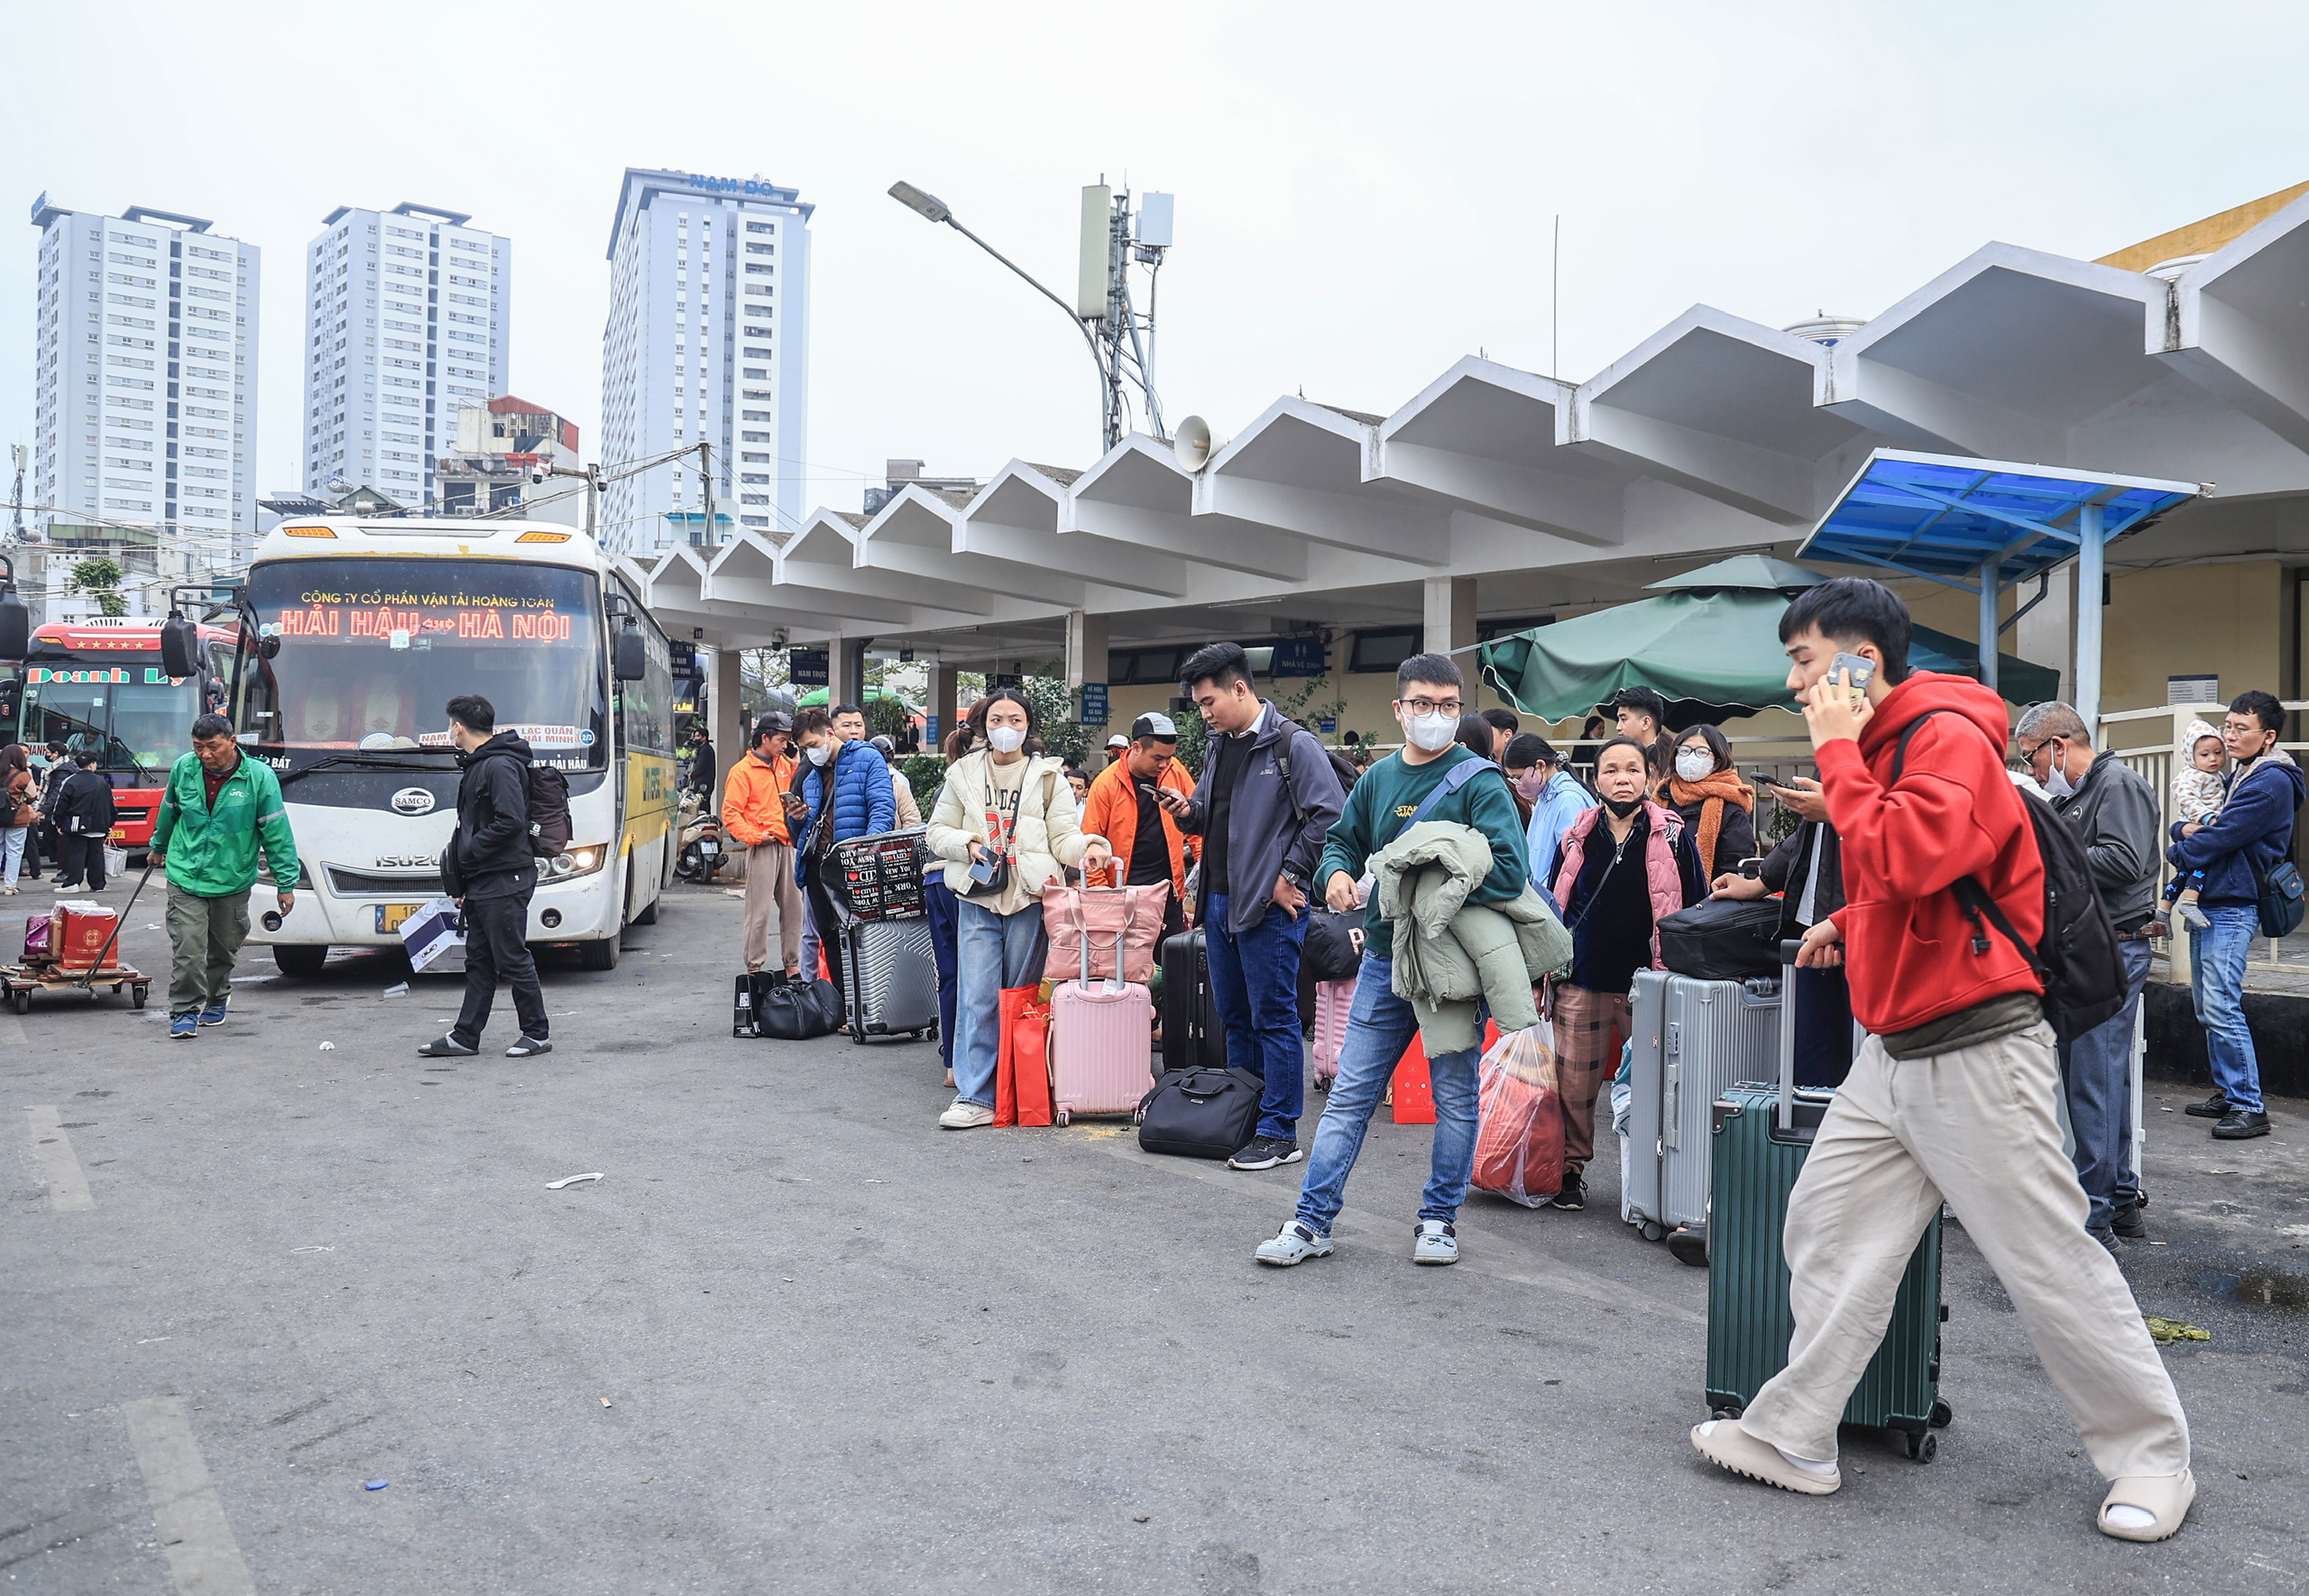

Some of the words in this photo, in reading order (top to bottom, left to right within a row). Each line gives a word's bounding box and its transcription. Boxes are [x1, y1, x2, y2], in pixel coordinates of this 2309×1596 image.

[690, 174, 737, 191] NAM
[301, 590, 341, 602] CÔNG
[345, 593, 357, 603] TY
[361, 589, 381, 604] CỔ
[421, 592, 447, 608] VẬN
[451, 592, 468, 606] TẢI
[281, 603, 339, 636] HẢI
[350, 606, 420, 640] HẬU
[458, 609, 503, 638] HÀ
[512, 610, 570, 643] NỘI
[28, 668, 130, 683] Doanh
[422, 734, 447, 742] NAM
[546, 736, 574, 744] MINH
[271, 755, 291, 768] BÁT
[549, 754, 566, 770] HẢI
[394, 797, 431, 805] SAMCO
